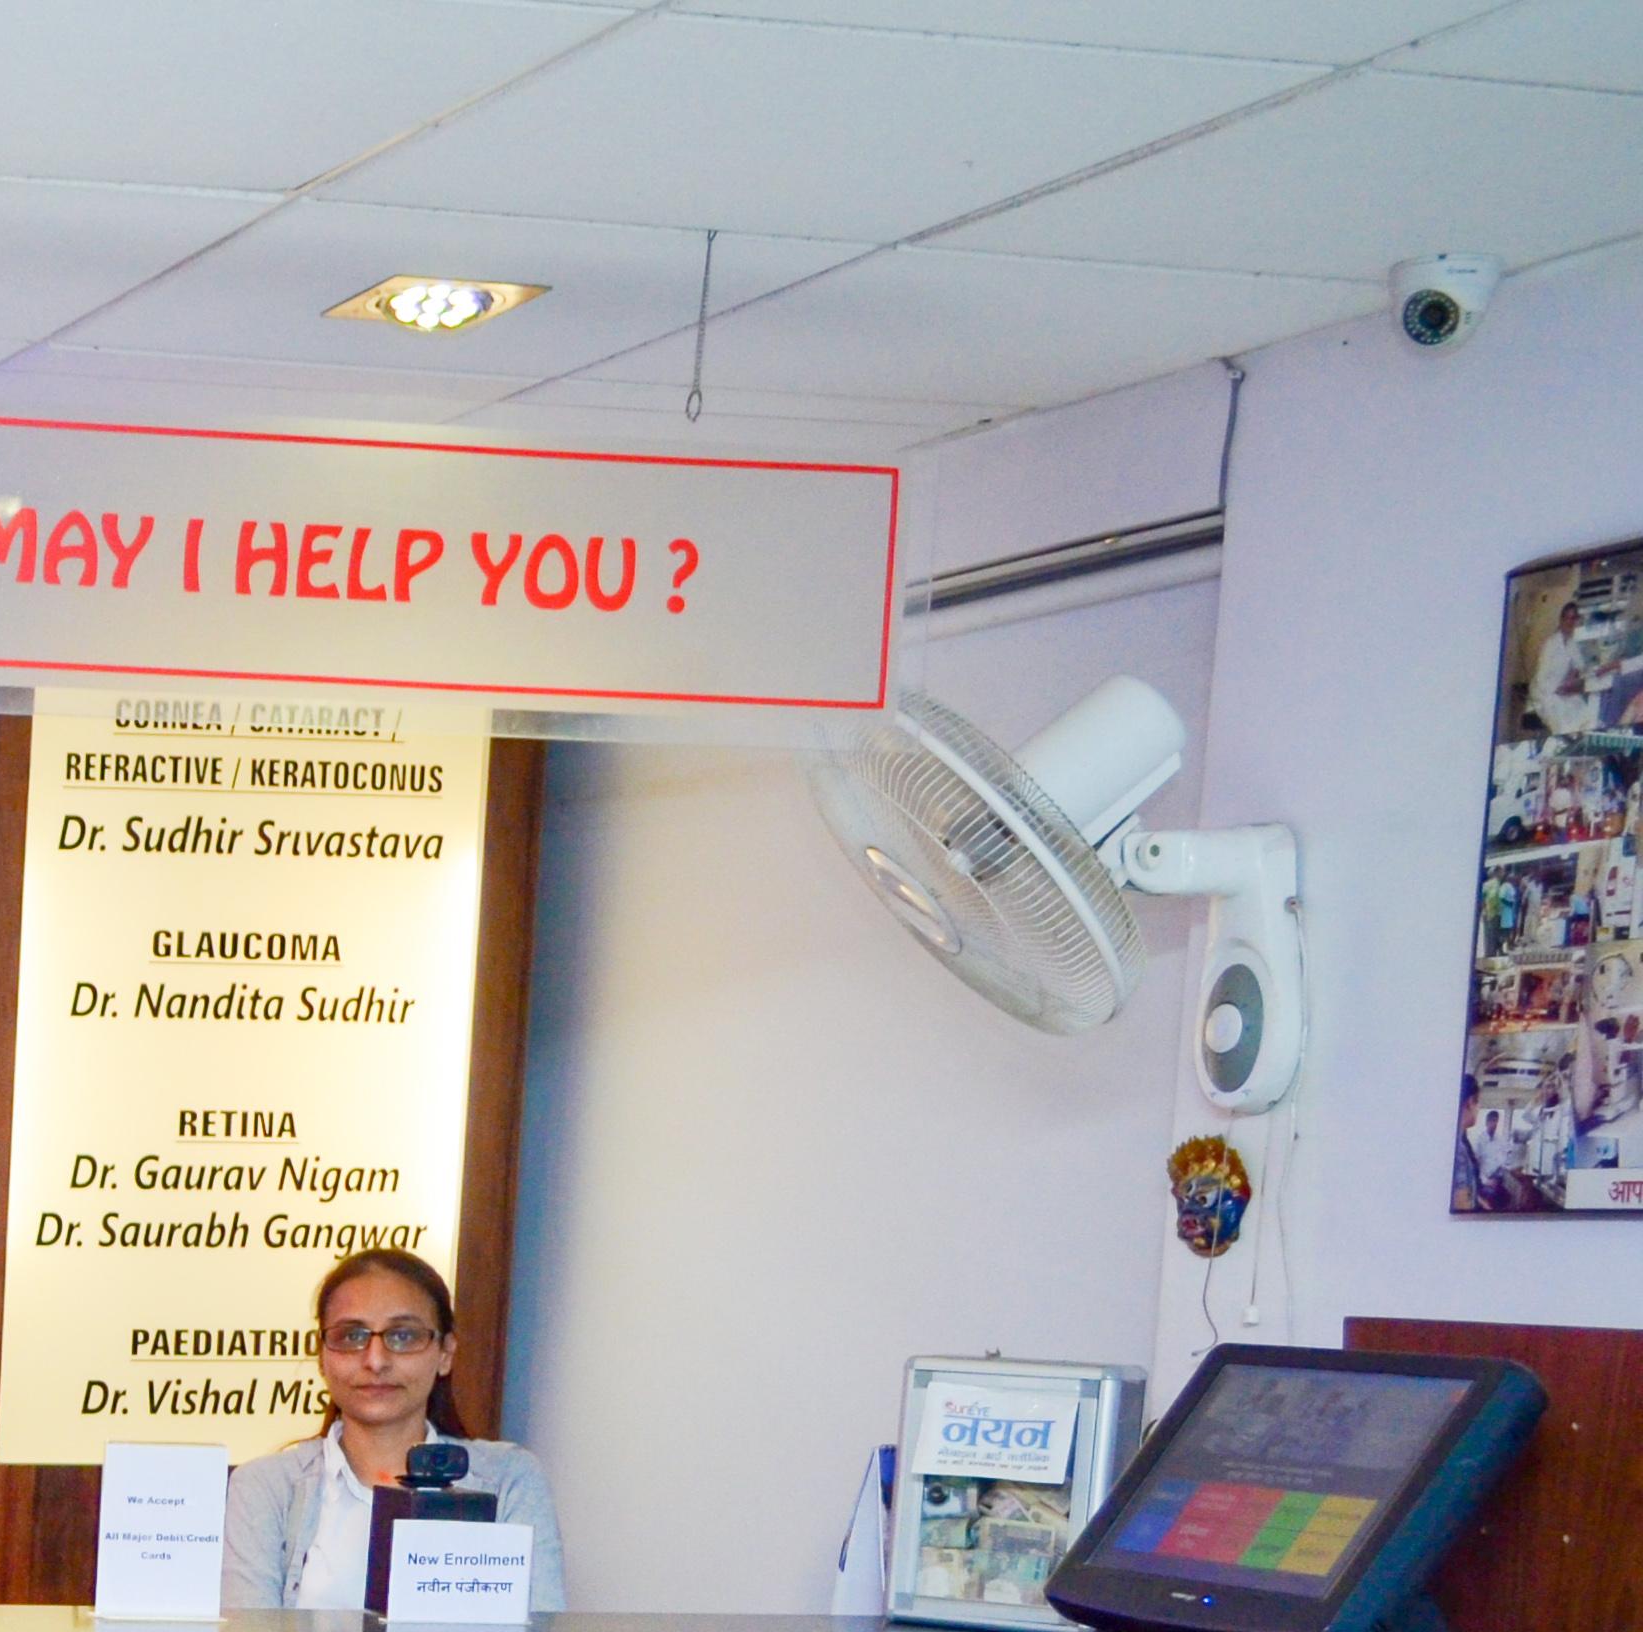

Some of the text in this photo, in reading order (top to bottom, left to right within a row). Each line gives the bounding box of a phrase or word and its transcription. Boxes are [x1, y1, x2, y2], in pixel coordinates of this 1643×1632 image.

[183, 518, 204, 593] I
[235, 520, 446, 603] HELP
[470, 531, 637, 612] YOU
[667, 538, 700, 614] ?
[66, 753, 443, 793] REFRACTIVE / KERATOCONUS
[59, 815, 106, 851] Dr.
[122, 816, 243, 854] Sudhir
[153, 930, 340, 961] GLAUCOMA
[71, 982, 414, 1023] Dr. Nandita Sudhir
[179, 1110, 296, 1138] RETINA
[70, 1155, 399, 1203] Dr. Gaurav Nigam
[36, 1211, 427, 1262] Dr. Saurabh Gangwar
[81, 1378, 330, 1416] Dr. Vishal Mis
[942, 1417, 1056, 1450] नयन
[408, 1553, 525, 1566] New Enrollment
[416, 1578, 451, 1593] नवीन
